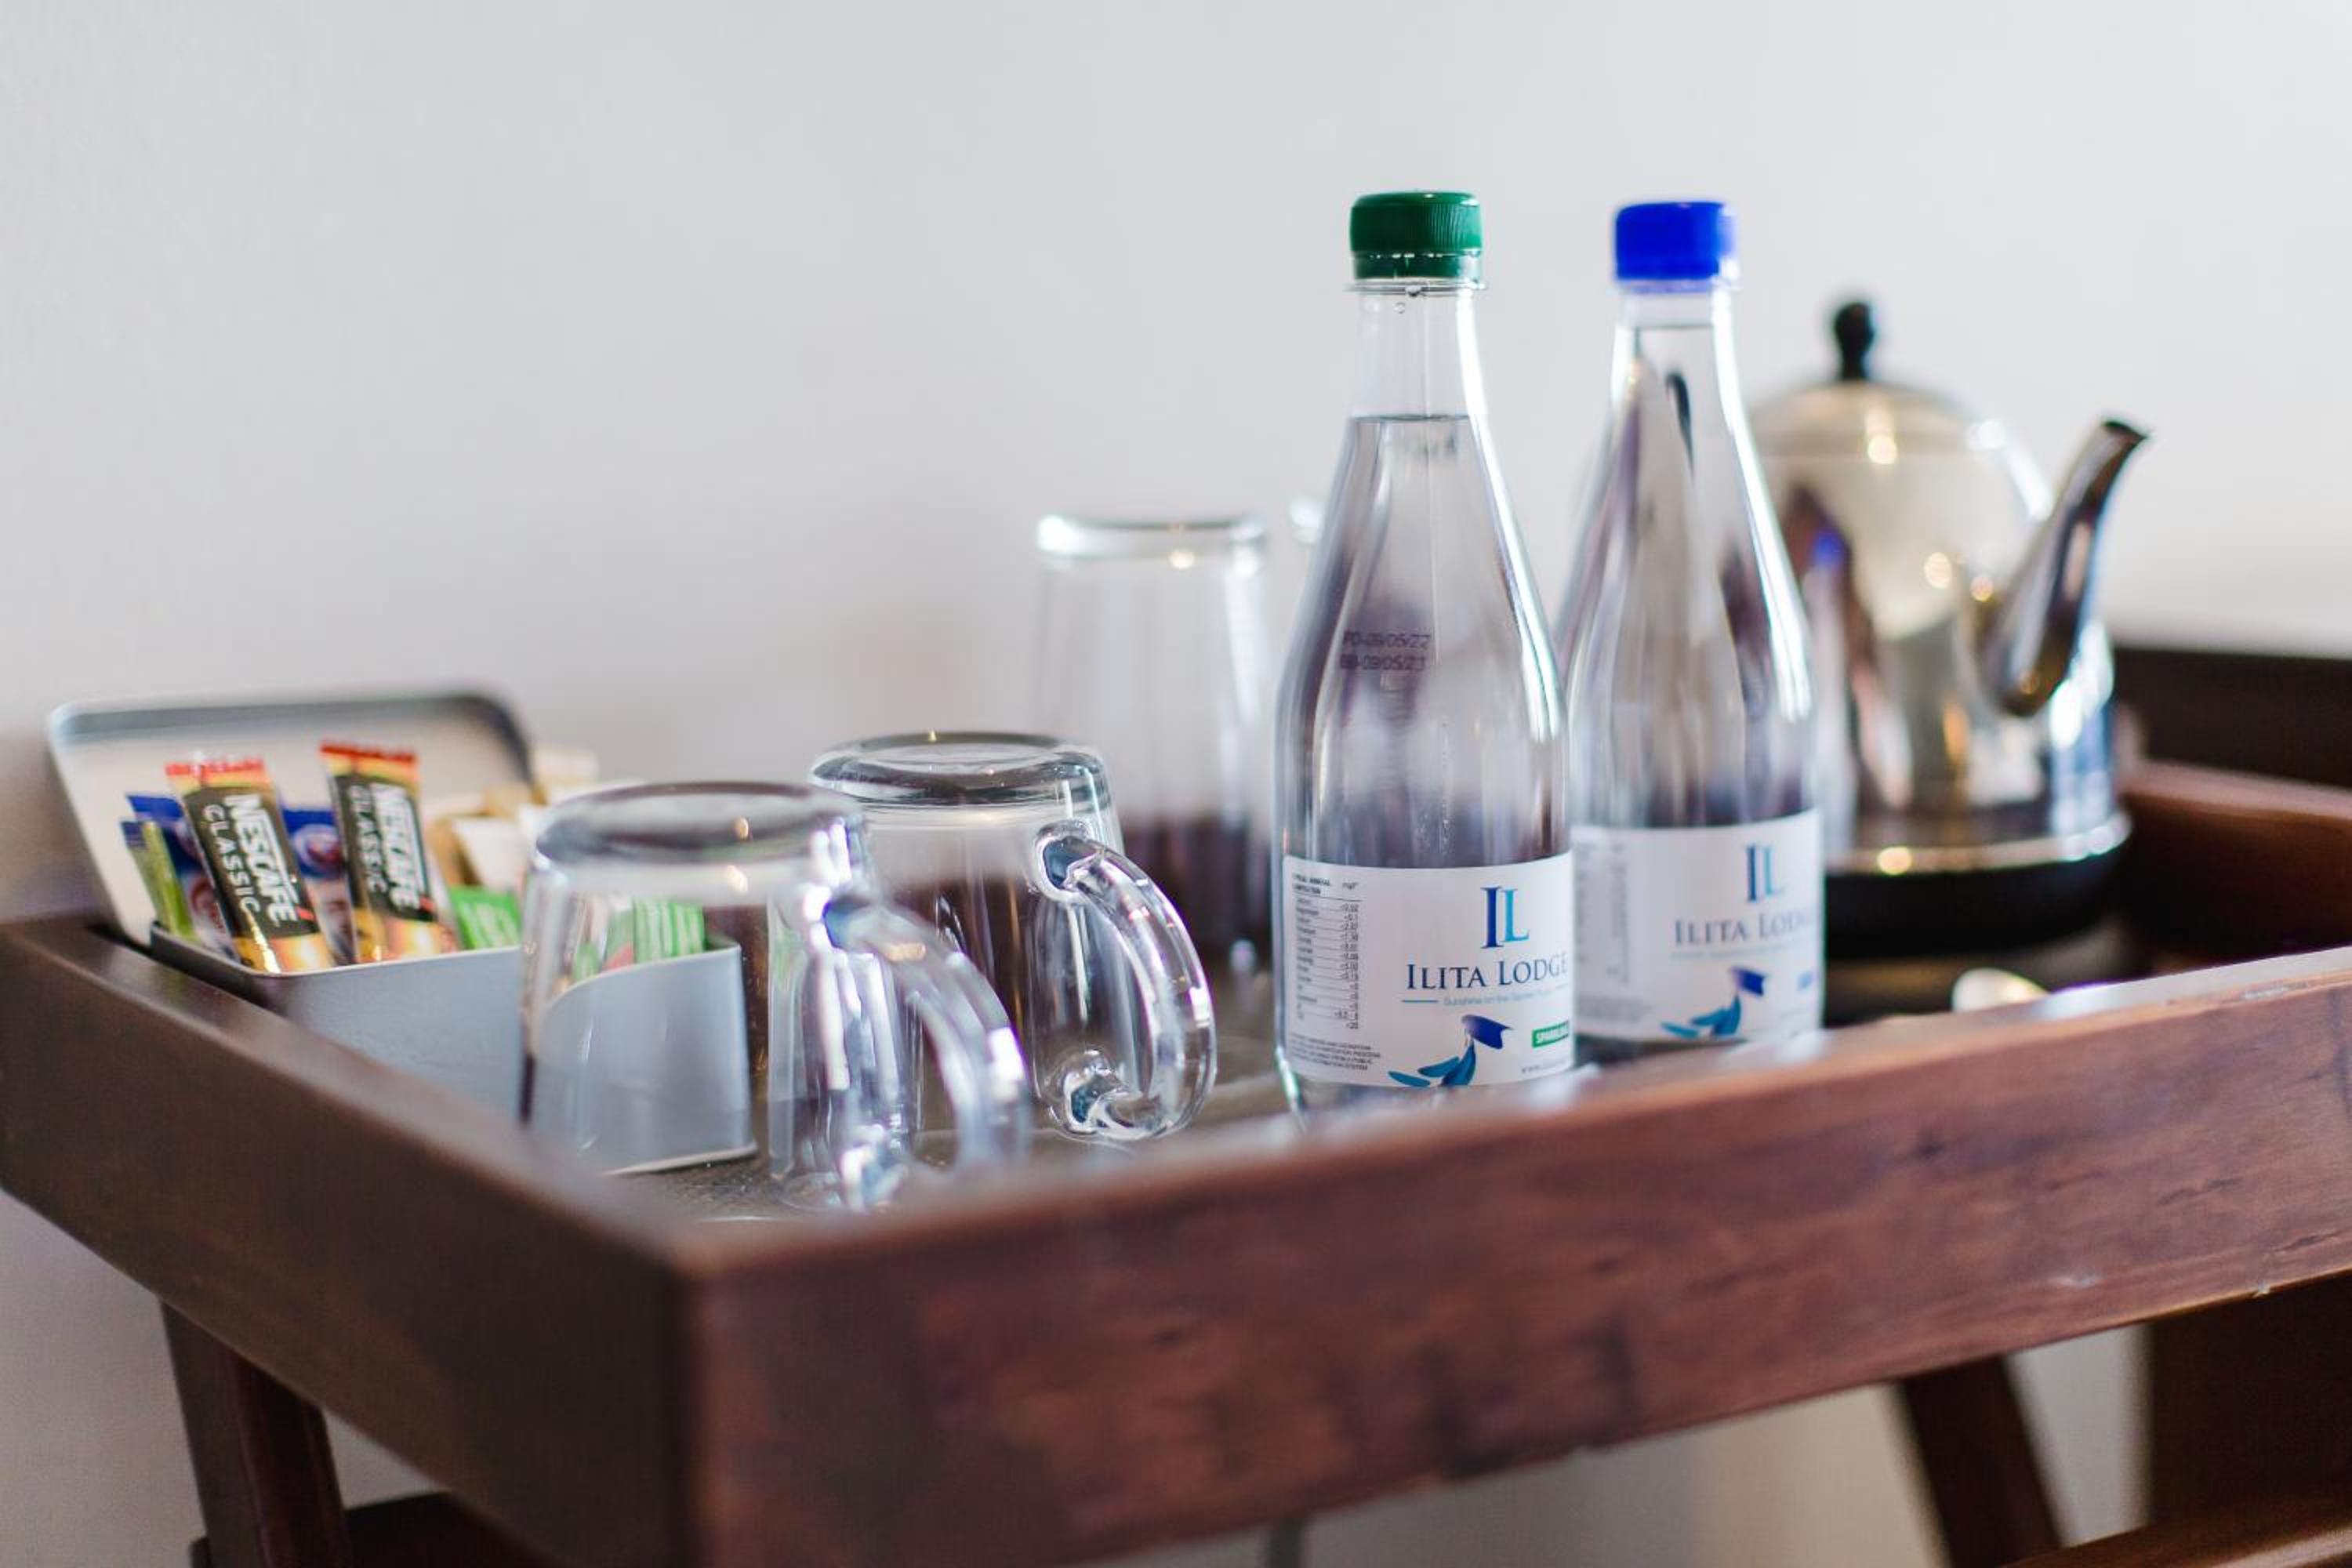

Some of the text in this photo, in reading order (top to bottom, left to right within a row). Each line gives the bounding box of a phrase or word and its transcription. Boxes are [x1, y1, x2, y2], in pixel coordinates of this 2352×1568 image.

[204, 804, 261, 913] CLASSIC
[347, 782, 390, 894] CLASSIC
[1480, 886, 1530, 949] IL
[1675, 919, 1748, 944] ILITA
[1406, 951, 1568, 990] ILITA LODGE
